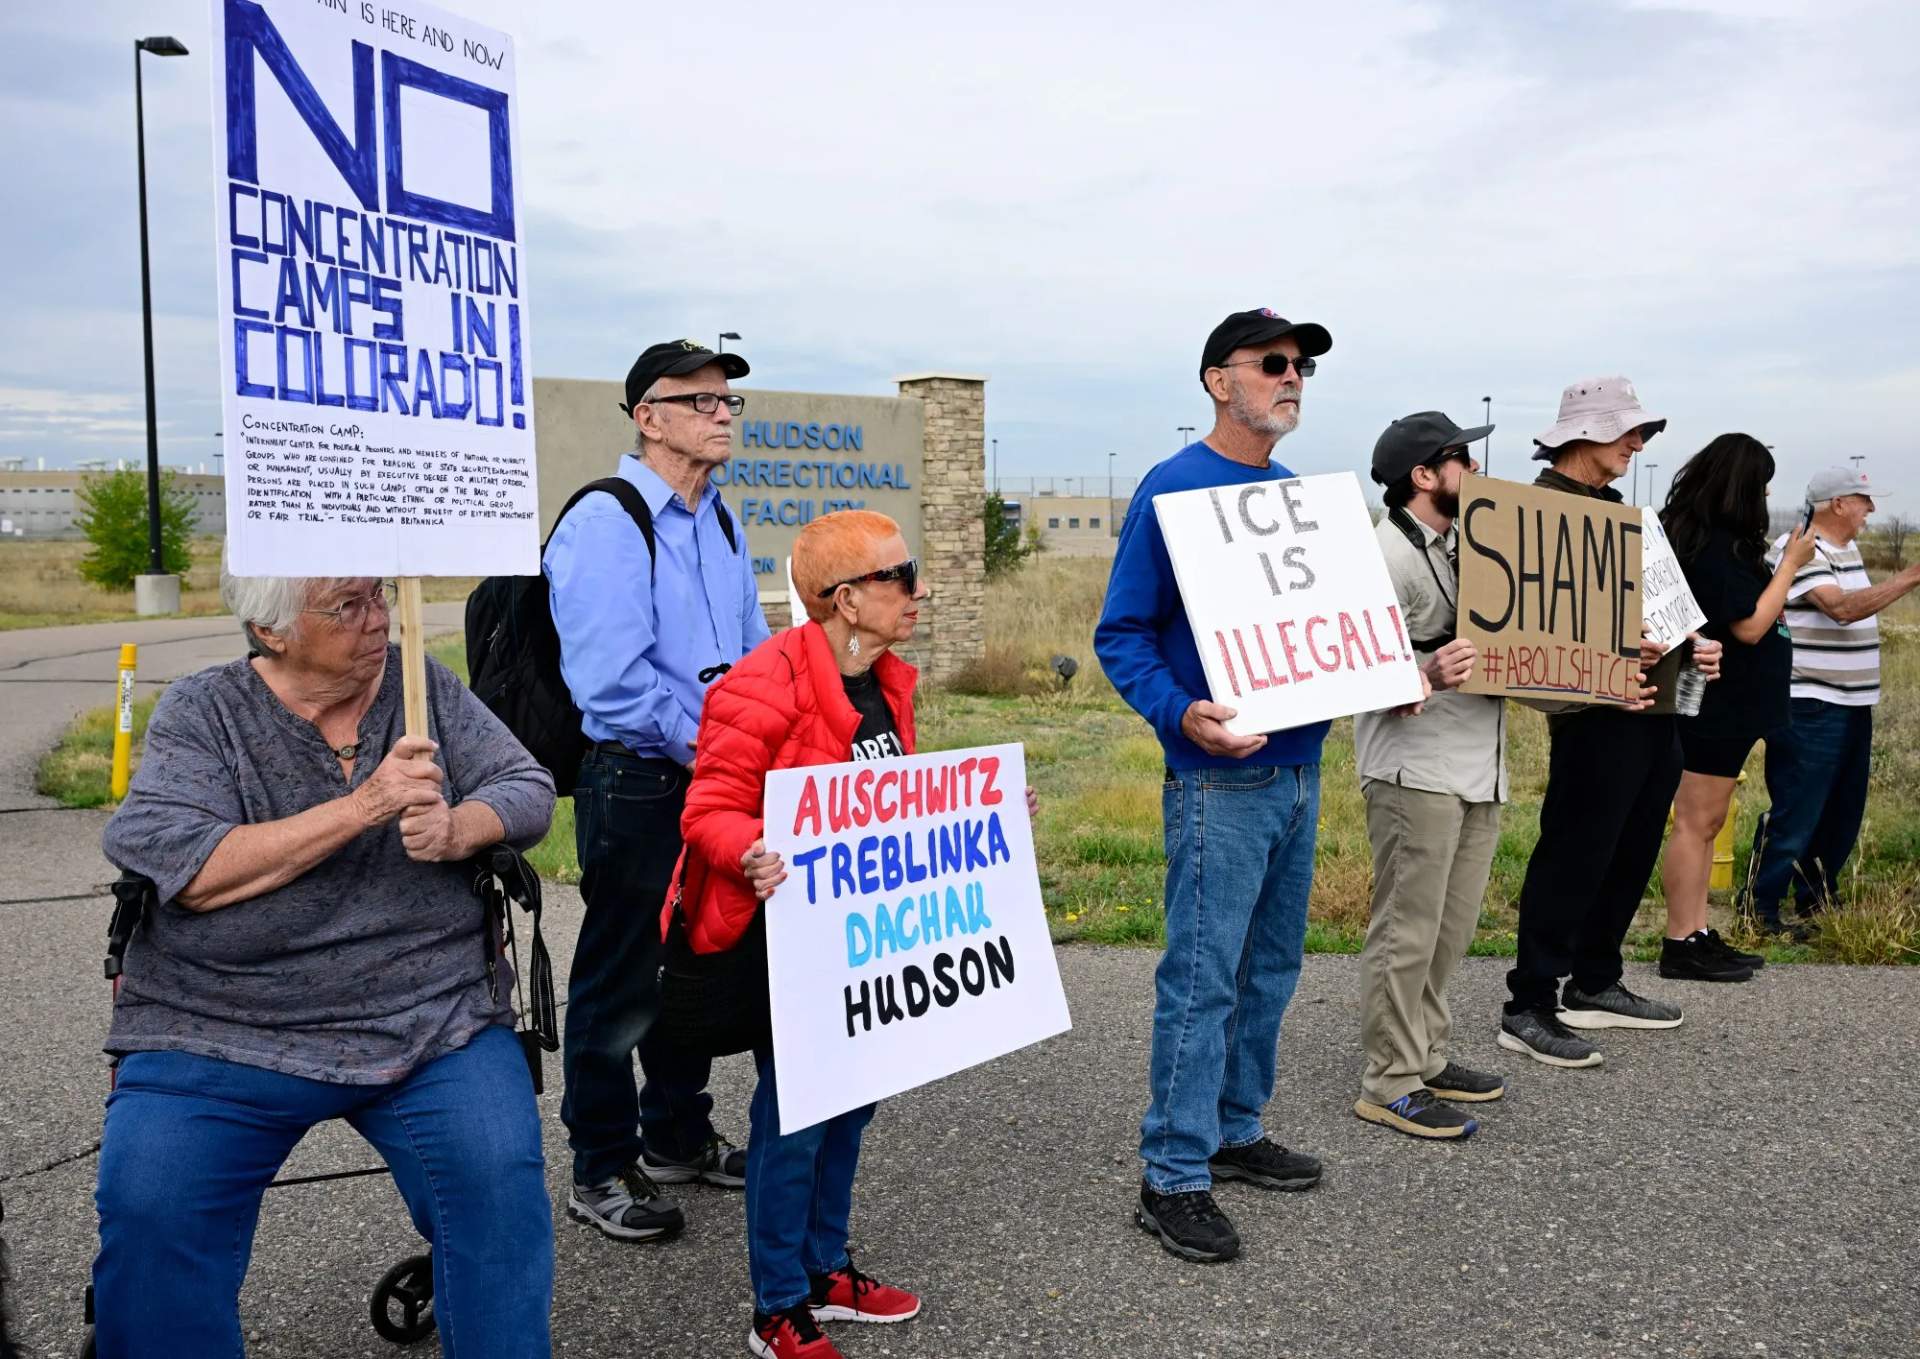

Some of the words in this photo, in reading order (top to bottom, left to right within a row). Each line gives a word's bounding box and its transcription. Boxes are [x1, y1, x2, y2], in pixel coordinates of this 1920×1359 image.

[361, 2, 374, 24] IS
[382, 8, 416, 39] HERE
[422, 24, 454, 52] AND
[463, 39, 504, 70] NOW
[224, 0, 516, 243] NO
[228, 182, 518, 298] CONCENTRATION
[231, 248, 404, 341] CAMPS
[451, 292, 497, 357] IN
[242, 414, 324, 434] CONCENTRATION
[330, 424, 364, 439] CAMP:
[318, 441, 330, 451] FOR
[415, 450, 447, 458] MEMBERS
[450, 451, 460, 459] OF
[742, 420, 864, 451] HUDSON
[245, 450, 276, 460] GROUPS
[283, 452, 300, 461] WHO
[305, 454, 318, 463] ARE
[319, 455, 354, 464] CONFINED
[362, 457, 376, 466] FOR
[383, 459, 416, 469] REASONS
[423, 462, 432, 470] OF
[440, 463, 457, 472] STATE
[247, 463, 260, 472] OR
[317, 466, 352, 479] USUALLY
[360, 469, 371, 478] BY
[377, 471, 421, 480] EXECUTIVE
[423, 474, 448, 482] DECREE
[454, 475, 464, 483] OR
[468, 476, 499, 486] MILITARY
[247, 475, 282, 485] PERSONS
[286, 478, 301, 487] ARE
[308, 479, 335, 489] PLACED
[341, 480, 349, 490] IN
[354, 481, 375, 491] SUCH
[380, 483, 406, 493] CAMPS
[414, 486, 434, 494] OFTEN
[439, 486, 449, 494] ON
[454, 486, 468, 496] THE
[474, 487, 488, 497] BASIS
[496, 490, 507, 499] OF
[711, 459, 912, 490] ORRECTIONAL
[247, 510, 262, 520] OR
[268, 511, 290, 522] FAIR
[341, 514, 394, 524] ENCYCLOPEDIA
[401, 516, 444, 526] BRITANNICA
[248, 488, 312, 500] IDENTIFICATION
[324, 491, 342, 500] WITH
[346, 492, 351, 501] A
[356, 492, 398, 503] PARTICULAR
[402, 494, 425, 503] ETHNIC
[434, 496, 445, 504] OR
[452, 498, 485, 507] POLITICAL
[248, 500, 277, 508] RATHER
[281, 500, 301, 509] THAN
[306, 502, 315, 510] AS
[321, 503, 361, 512] INDIVIDUALS
[365, 504, 381, 514] AND
[385, 506, 416, 514] WITHOUT
[424, 508, 453, 516] BENEFIT
[458, 509, 467, 517] OF
[471, 509, 497, 518] EITHER
[500, 510, 534, 520] INDICTMENT
[1208, 479, 1319, 544] ICE
[1257, 546, 1316, 596] IS
[1464, 497, 1642, 658] SHAME
[1215, 604, 1412, 698] ILLEGAL!
[793, 757, 1003, 836] AUSCHWITZ
[793, 811, 1010, 904] TREBLINKA
[846, 881, 992, 968] DACHAU
[844, 935, 1015, 1038] HUDSON
